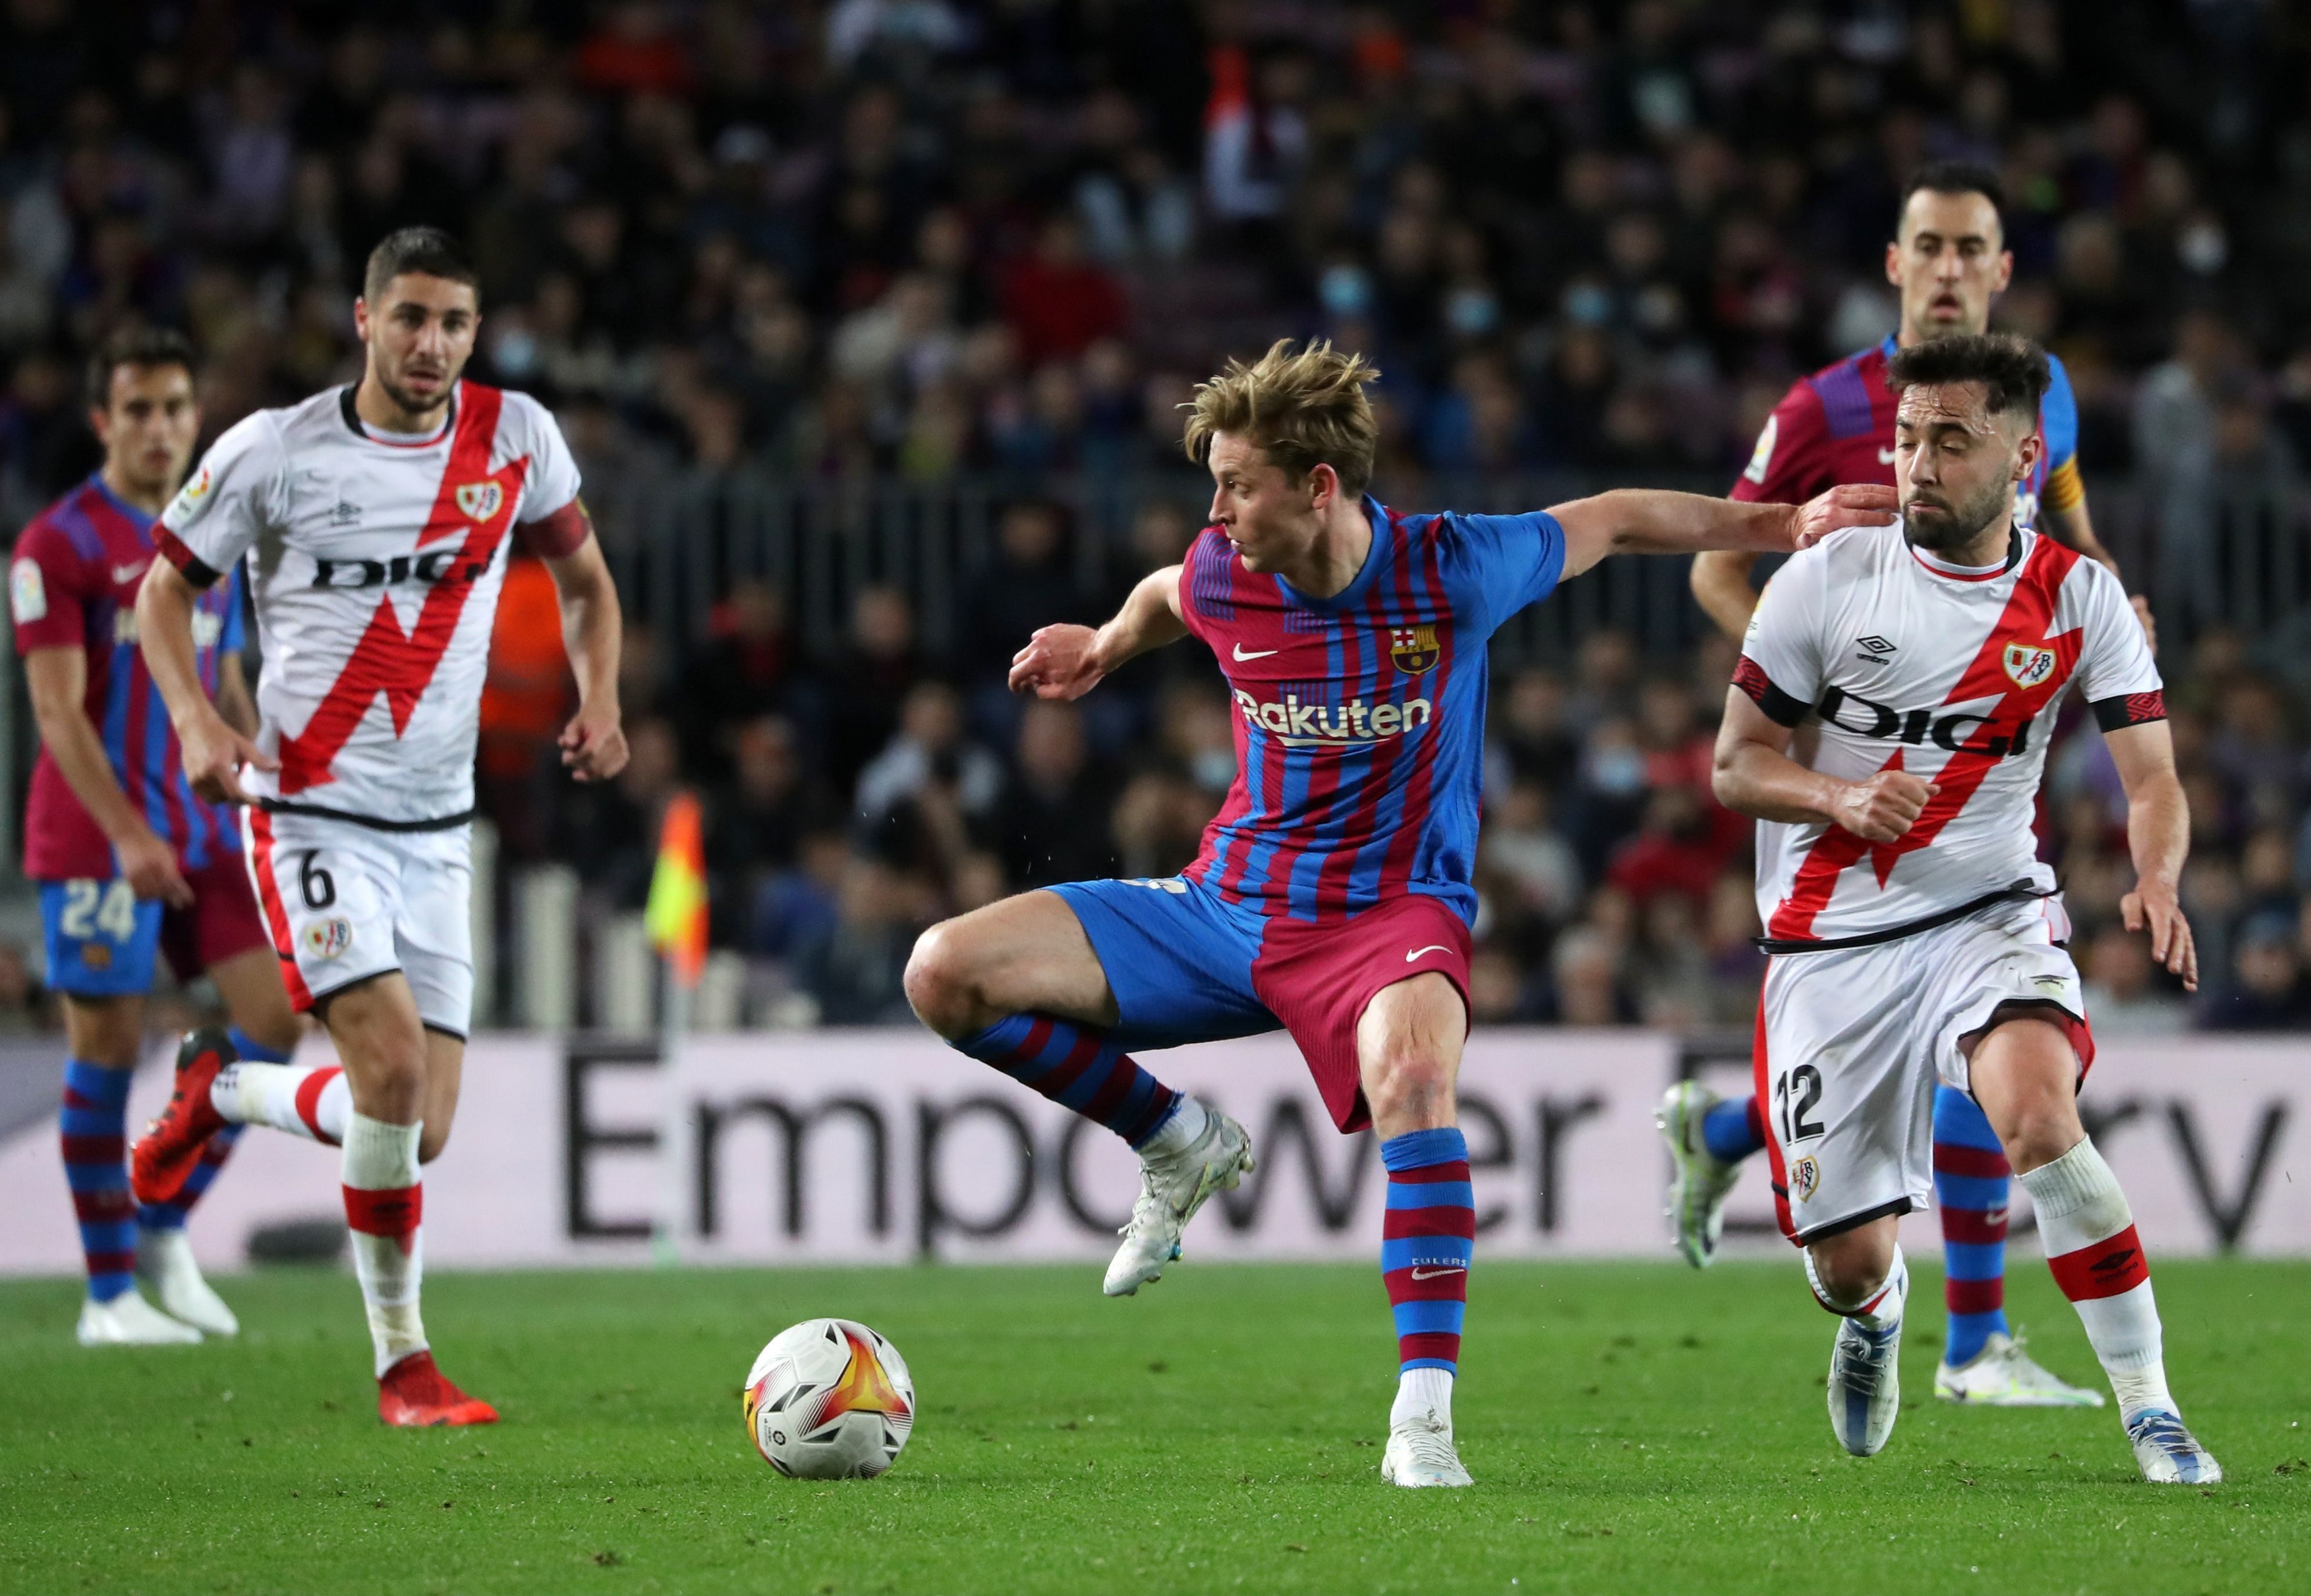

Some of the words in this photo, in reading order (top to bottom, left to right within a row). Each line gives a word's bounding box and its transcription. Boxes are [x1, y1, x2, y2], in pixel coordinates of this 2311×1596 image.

[1234, 688, 1432, 738] Rakuten
[1817, 685, 2034, 756] DIGI
[61, 878, 136, 943] 24
[299, 850, 337, 912] 6
[1775, 1064, 1825, 1147] 12
[1412, 1257, 1467, 1267] CULERS
